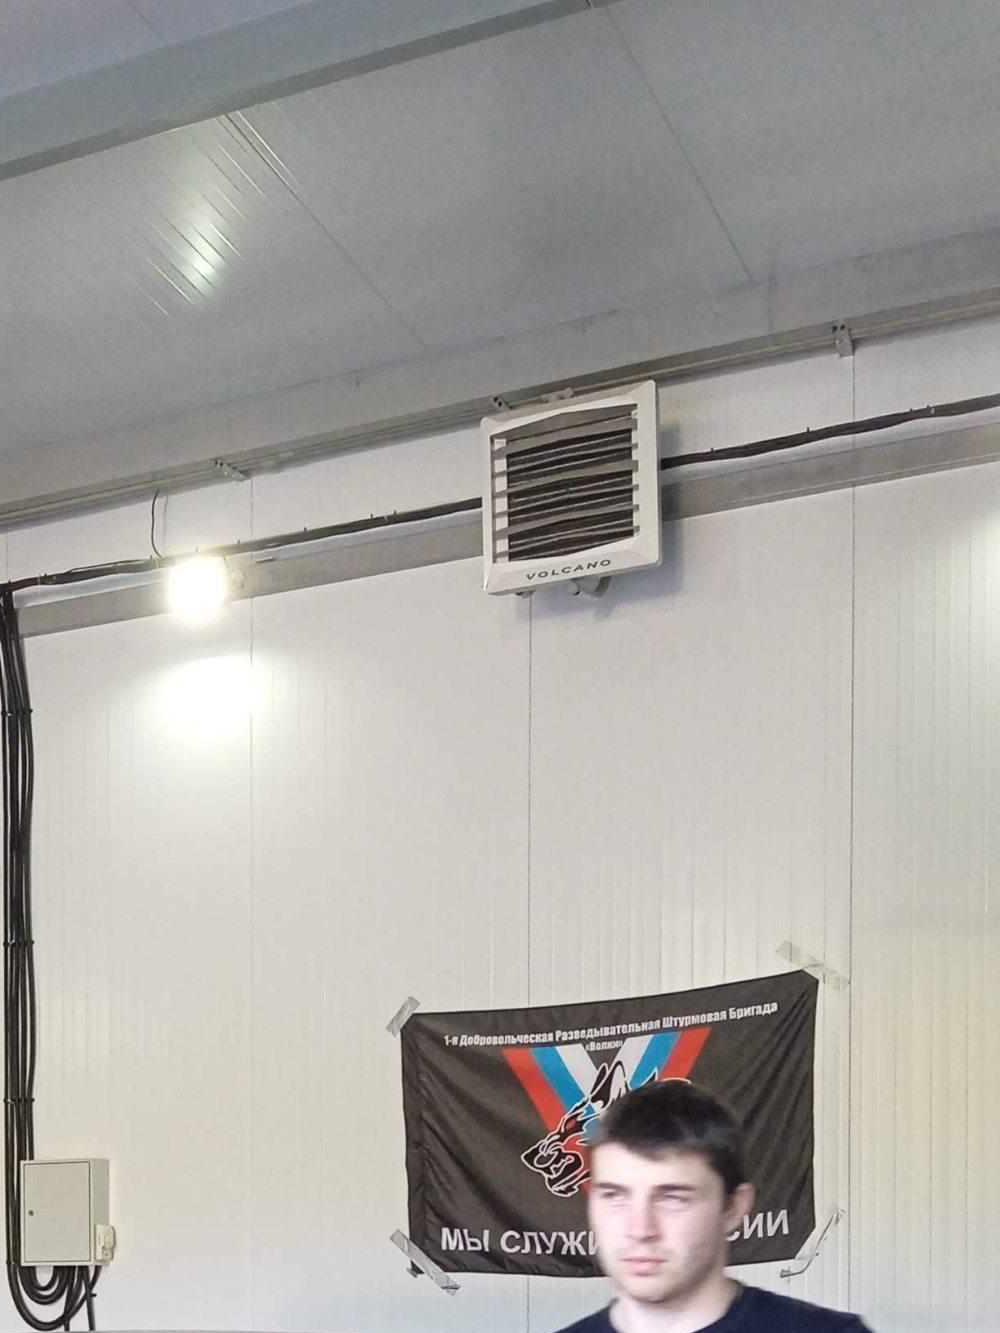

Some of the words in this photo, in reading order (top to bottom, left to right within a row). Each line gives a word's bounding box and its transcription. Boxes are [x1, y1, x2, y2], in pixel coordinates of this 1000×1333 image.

[526, 558, 612, 581] VOLCANO
[444, 1034, 458, 1046] 1-я
[459, 1032, 552, 1047] Добровольческая
[555, 1019, 660, 1043] Разведывательная
[662, 1010, 727, 1028] Штурмовая
[729, 1001, 778, 1020] Бригада
[441, 1227, 490, 1253] МЫ
[501, 1229, 600, 1256] СЛУЖИ
